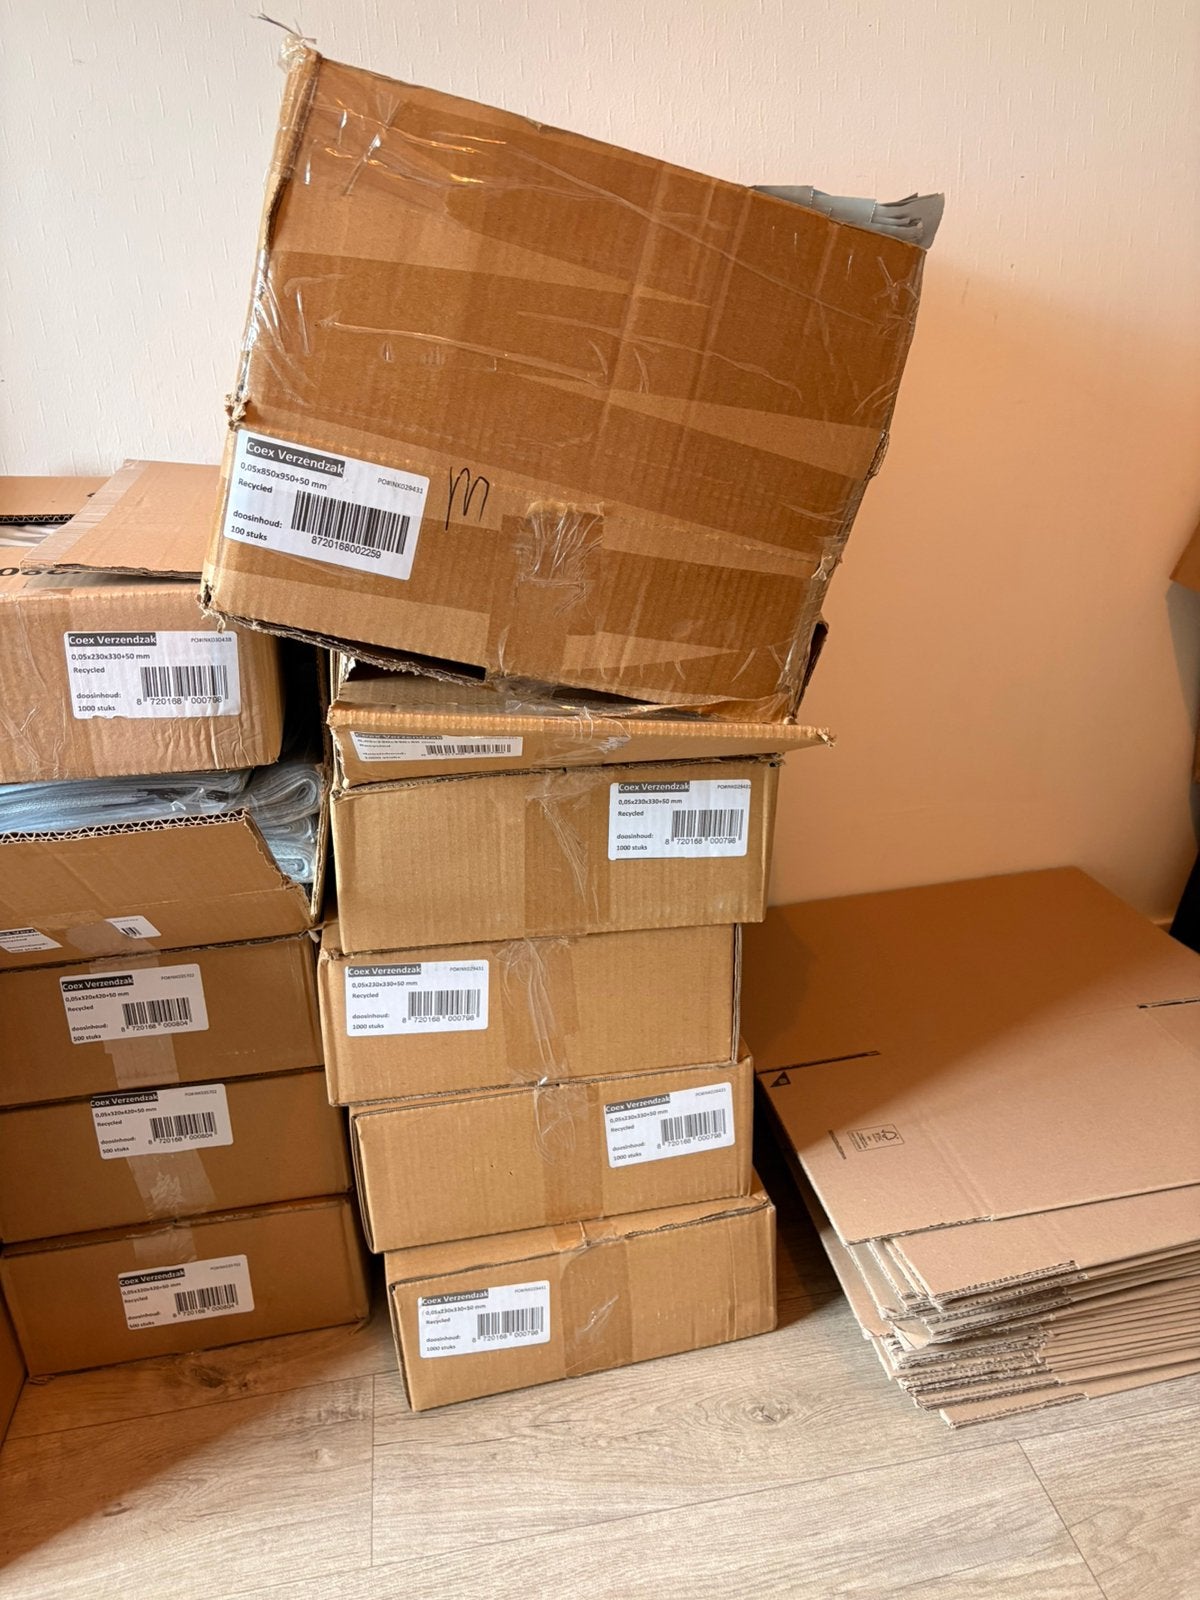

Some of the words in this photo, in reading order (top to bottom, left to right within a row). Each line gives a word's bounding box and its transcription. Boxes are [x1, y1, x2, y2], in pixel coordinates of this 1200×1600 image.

[247, 441, 274, 458] Coex
[278, 450, 344, 475] Verzendzak
[241, 462, 310, 486] 0,05x850x950+50
[311, 481, 327, 490] mm
[238, 478, 272, 493] Recycled
[233, 510, 282, 529] doosinhoud:
[231, 526, 244, 536] 100
[246, 530, 267, 541] stuks
[311, 536, 381, 559] 8720168002259
[70, 636, 95, 644] Coex
[98, 635, 156, 644] Verzendzak
[85, 978, 134, 988] Verzendzak
[111, 1094, 158, 1105] Verzendzak
[626, 1096, 670, 1109] Verzendzak
[141, 1271, 185, 1282] Verzendzak
[443, 1291, 489, 1301] Verzendzak
